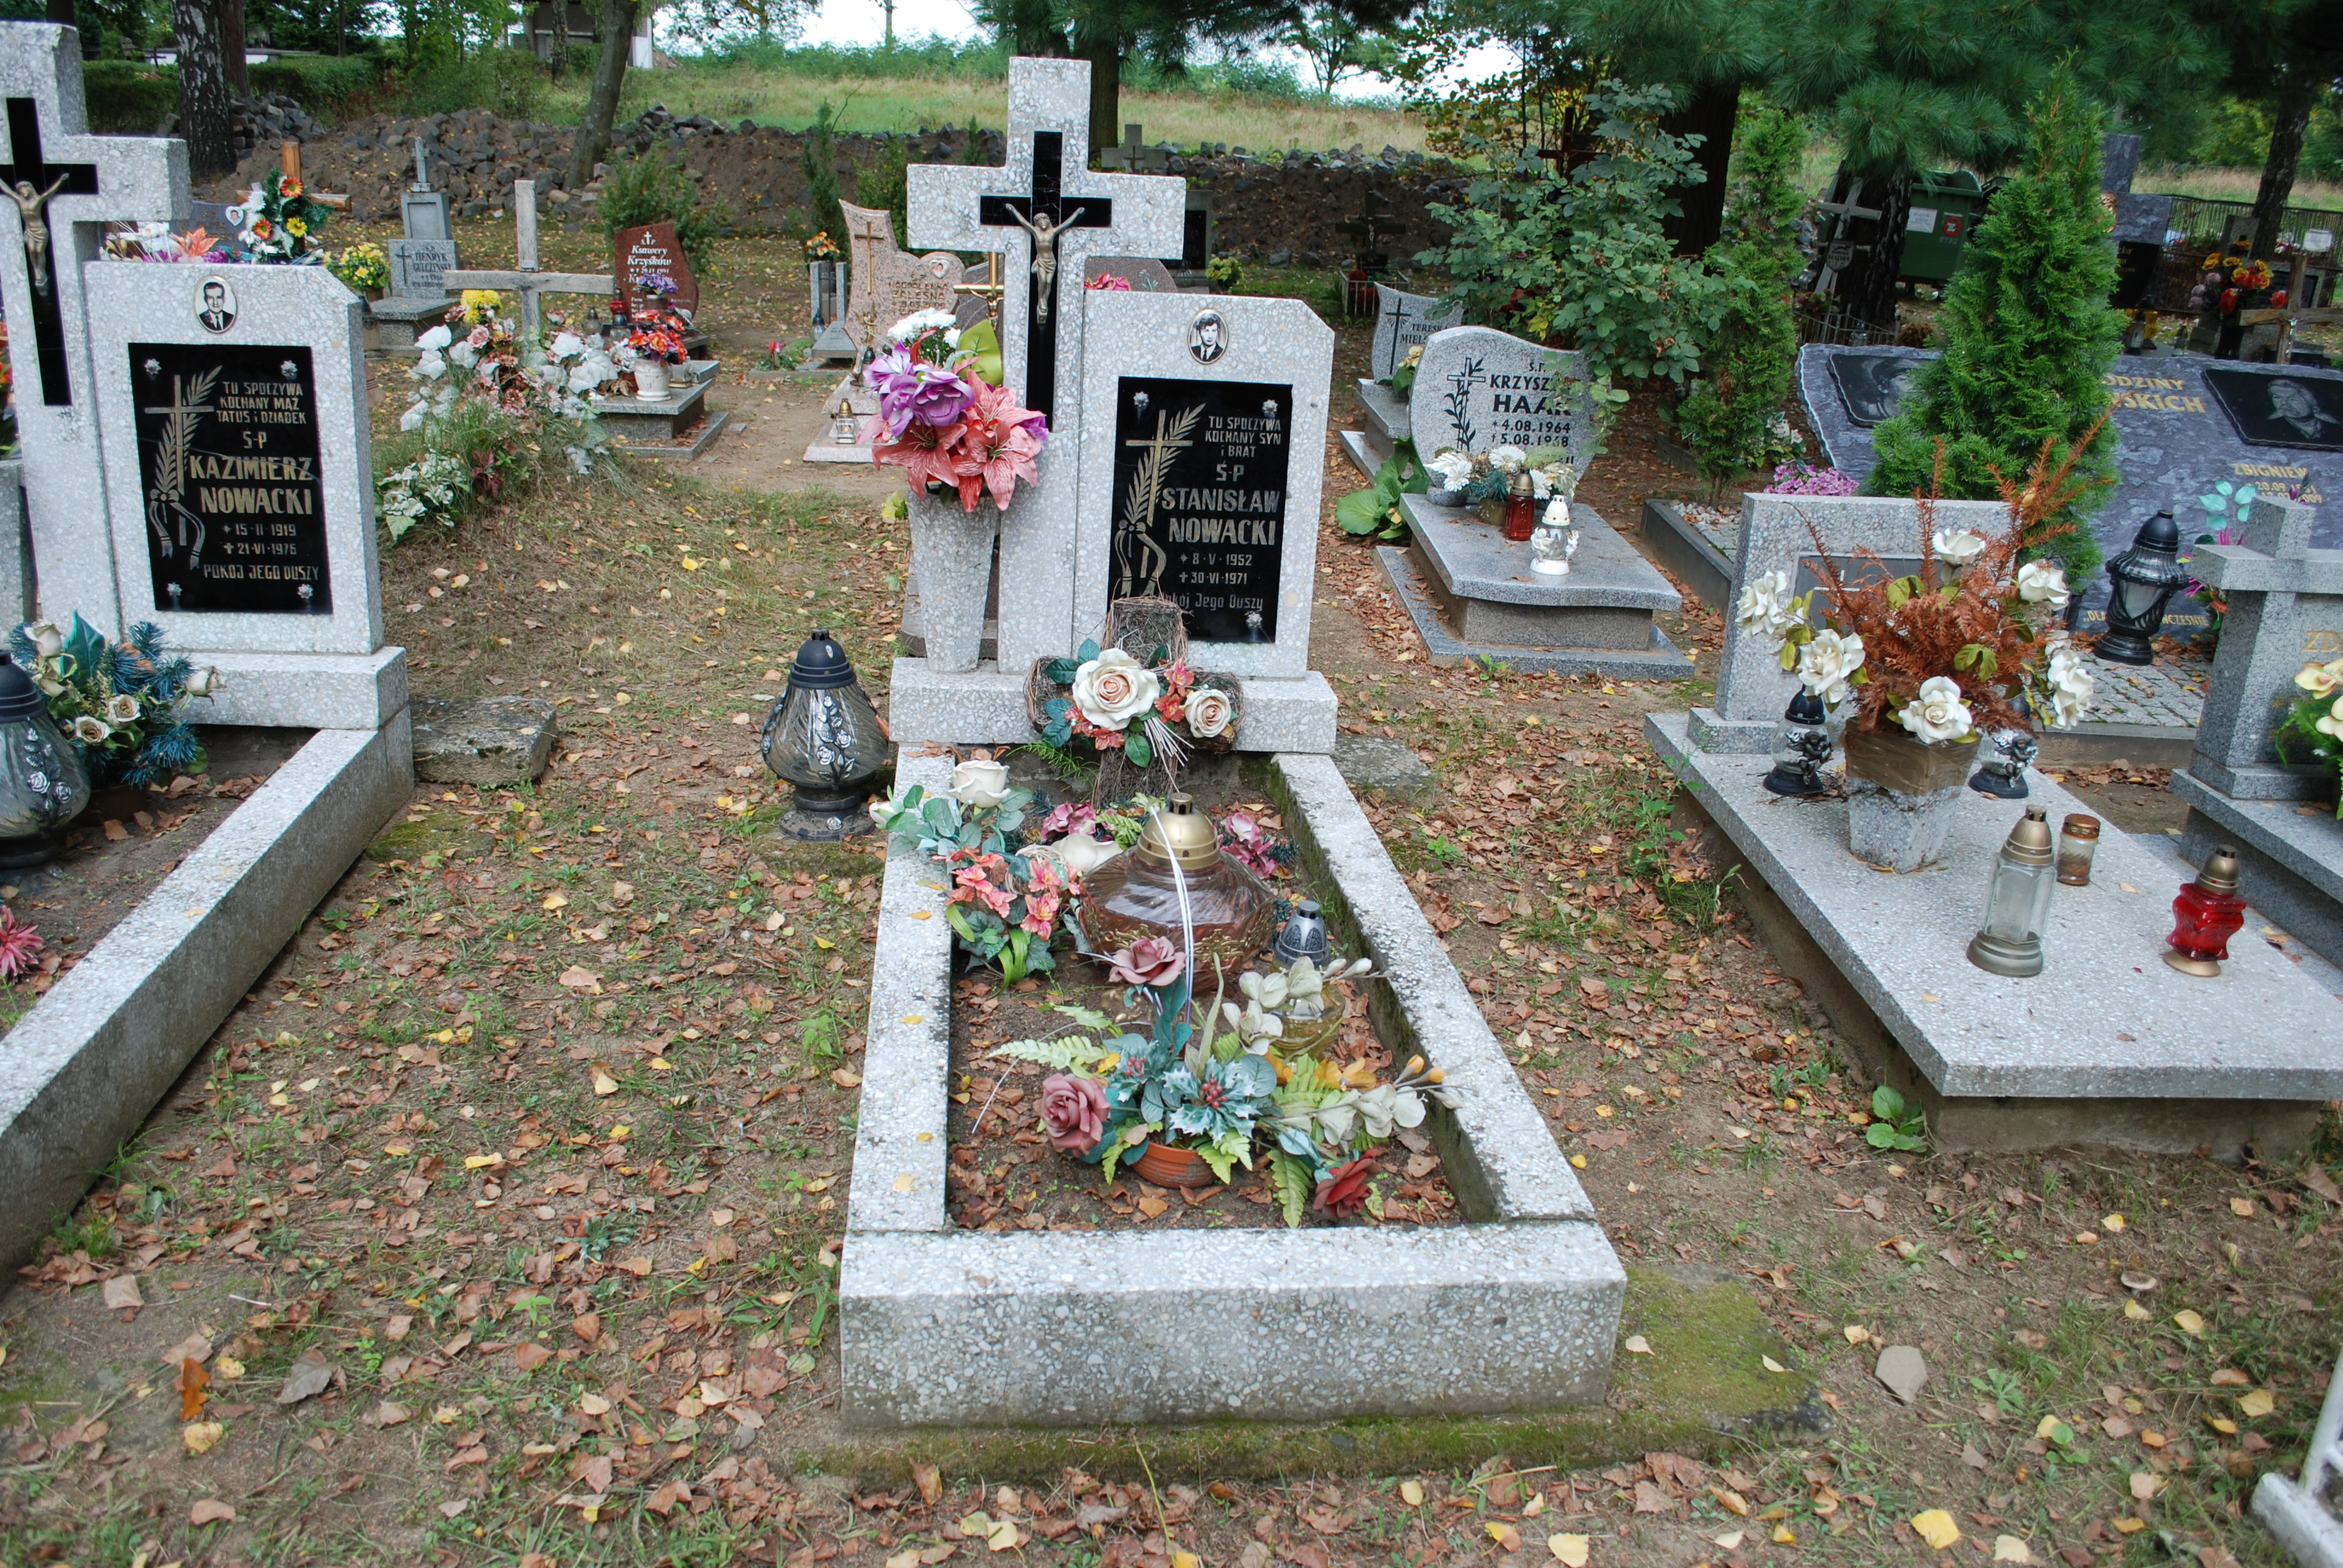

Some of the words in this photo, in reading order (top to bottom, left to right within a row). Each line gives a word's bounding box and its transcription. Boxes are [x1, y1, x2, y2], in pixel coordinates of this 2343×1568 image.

[415, 252, 448, 261] HENRYK
[223, 381, 239, 394] TU
[243, 382, 303, 396] SPOCZYWA
[220, 396, 269, 410] KOCHANY
[261, 411, 307, 424] DZIADEK
[1208, 416, 1223, 429] TU
[1227, 417, 1282, 431] SPOCZYWA
[1205, 430, 1255, 444] KOCHANY
[1259, 433, 1282, 445] SYN
[1221, 445, 1225, 457] i
[1228, 445, 1257, 458] BRAT
[189, 454, 313, 481] KAZIMIERZ
[2230, 463, 2308, 479] ZBIGNIEW
[200, 487, 313, 515] NOWACKI
[1161, 486, 1280, 514] STANISŁAW
[1168, 517, 1276, 546] NOWACKI
[249, 564, 281, 580] JEGO
[283, 565, 320, 581] DUSZY
[1196, 593, 1224, 611] Jego
[1229, 594, 1263, 612] Duszy
